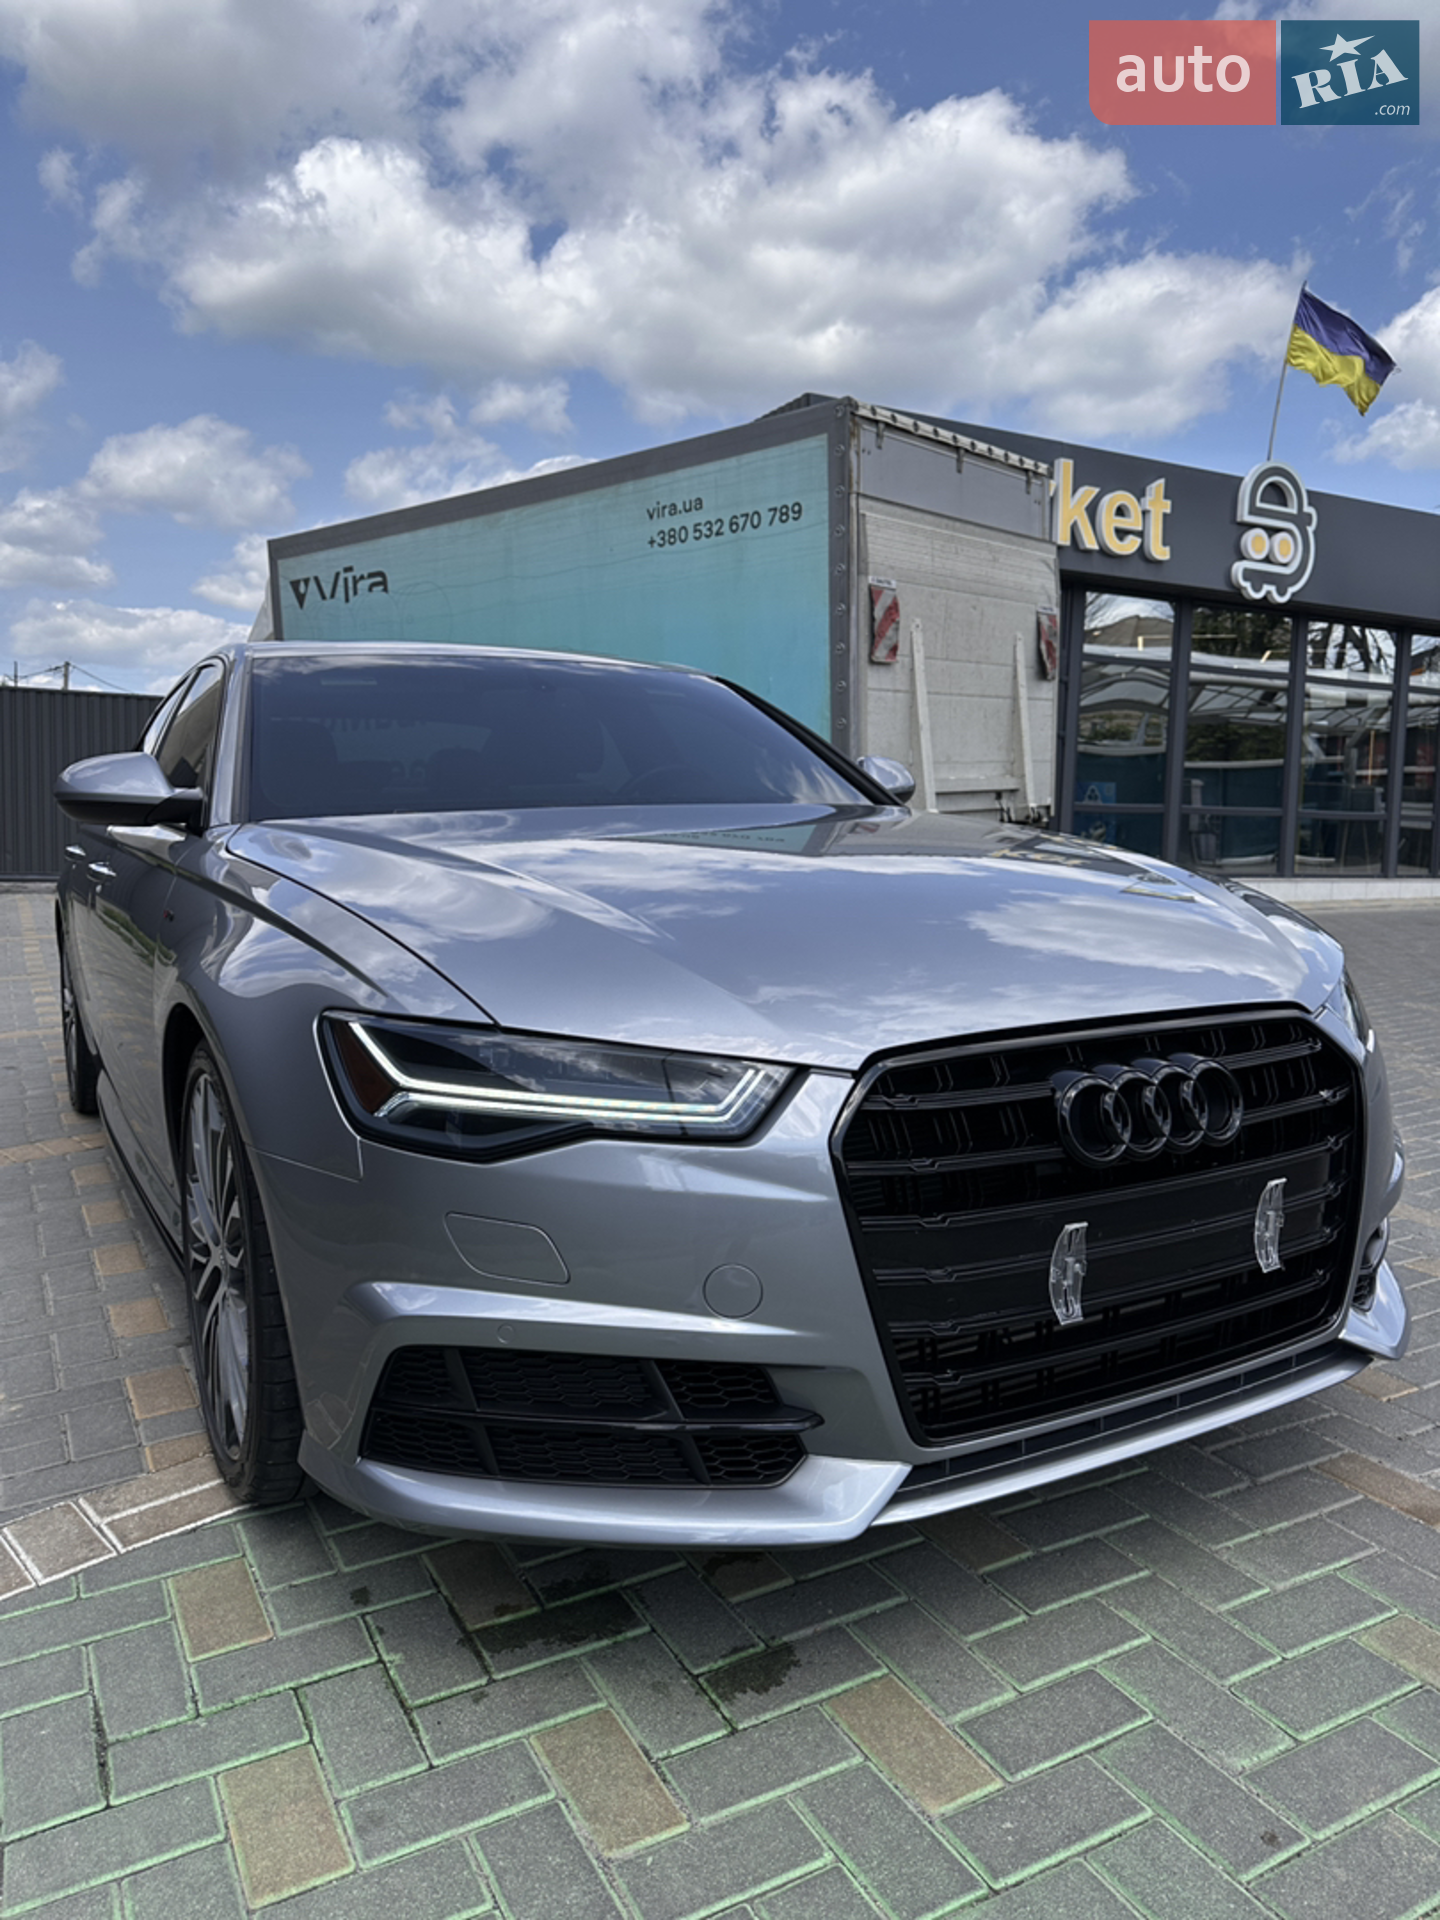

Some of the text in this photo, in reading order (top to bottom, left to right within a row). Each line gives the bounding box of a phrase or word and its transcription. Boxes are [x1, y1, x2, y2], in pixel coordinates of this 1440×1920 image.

[646, 497, 704, 521] vira.ua
[647, 501, 803, 548] +380 532 670 789
[1051, 457, 1171, 561] ket
